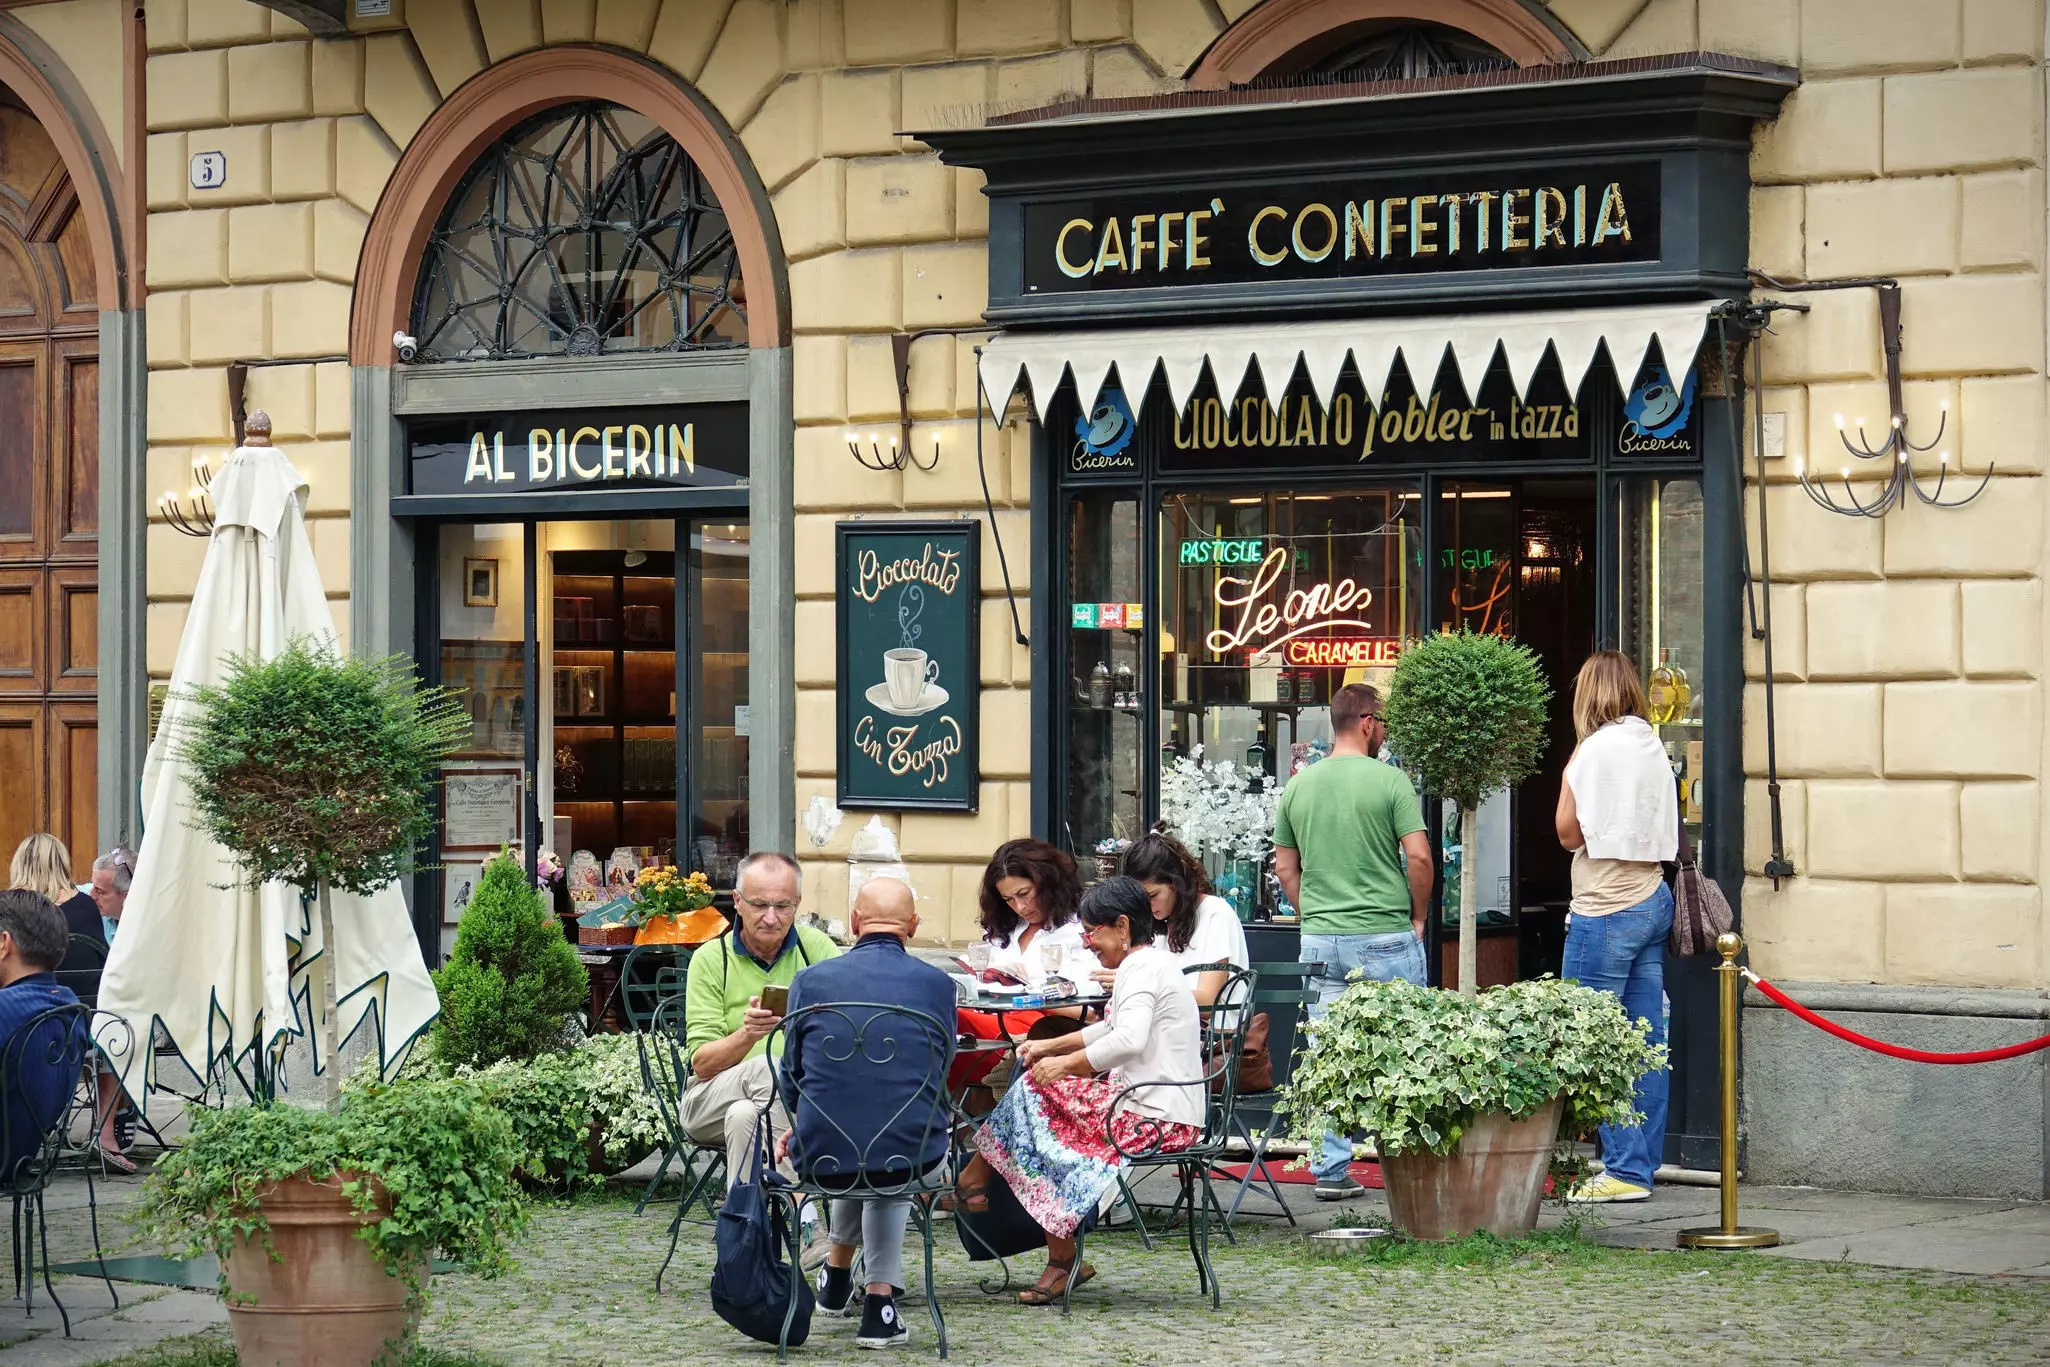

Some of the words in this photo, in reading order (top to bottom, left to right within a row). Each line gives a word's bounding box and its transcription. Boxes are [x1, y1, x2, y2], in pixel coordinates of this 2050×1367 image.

[203, 157, 213, 182] 5
[1247, 181, 1633, 266] CONFETTERIA
[1489, 410, 1505, 440] in
[1510, 396, 1580, 440] tazza
[1618, 420, 1692, 454] Bicerin
[463, 431, 516, 485] AL
[528, 423, 695, 483] BICERIN
[1071, 438, 1135, 471] Bicerin
[852, 542, 962, 604] Cioccolato
[1289, 641, 1397, 665] CARAMELLE
[854, 714, 884, 767] in
[887, 714, 963, 789] Tazza
